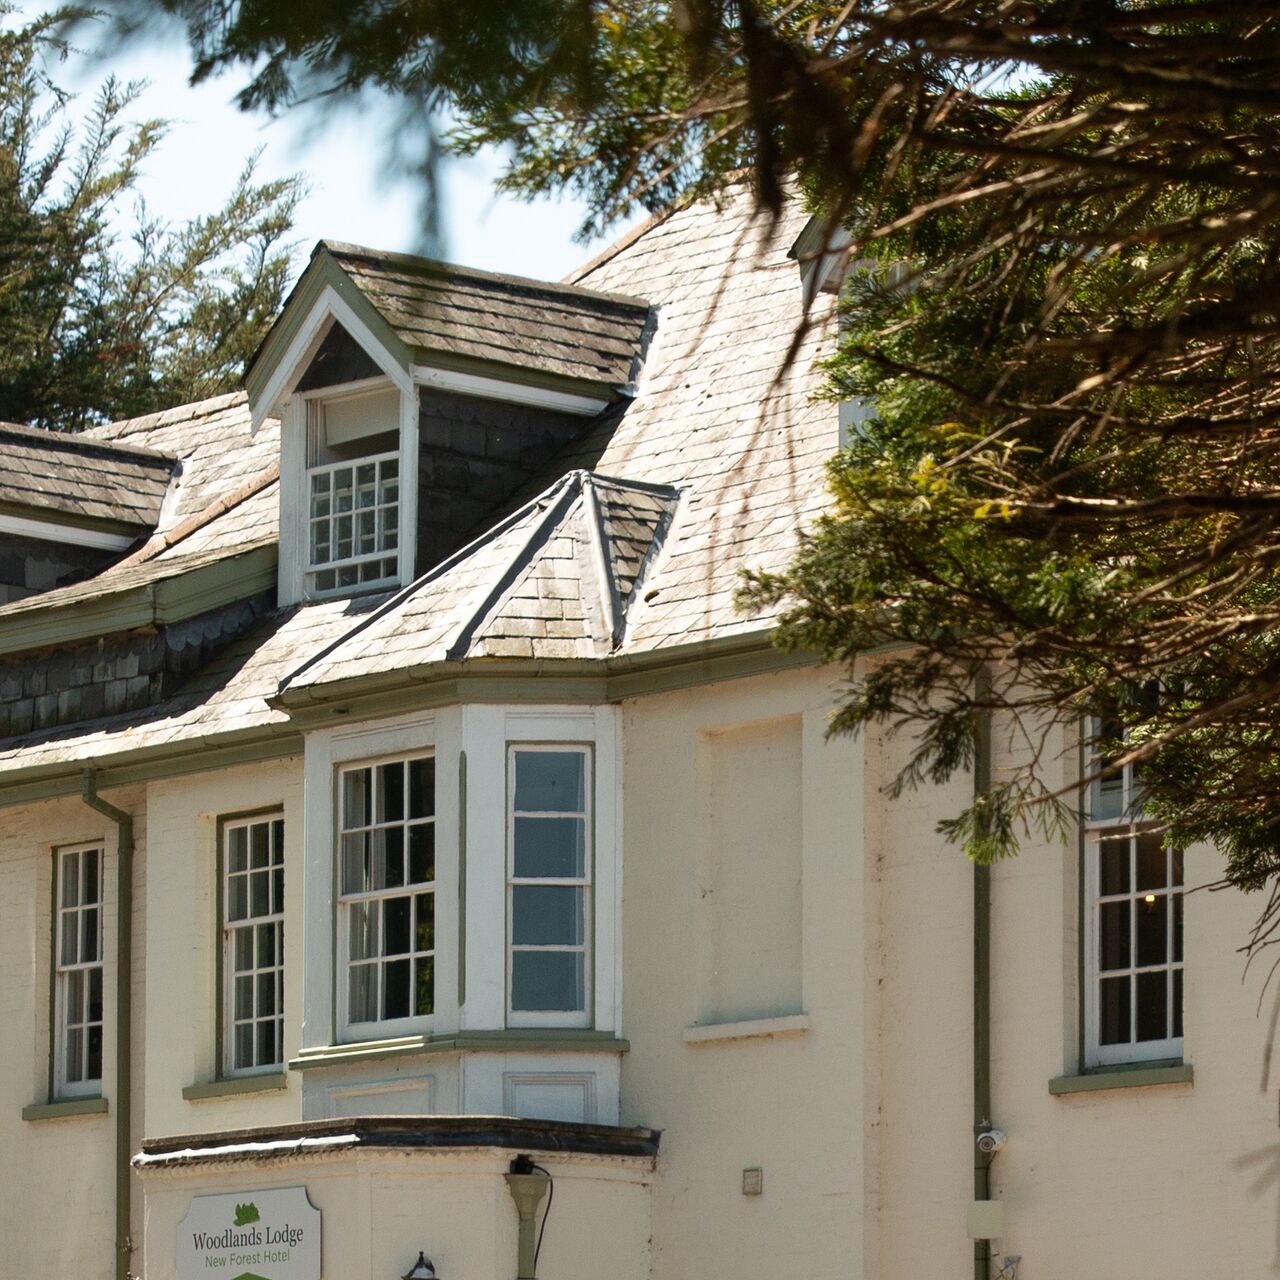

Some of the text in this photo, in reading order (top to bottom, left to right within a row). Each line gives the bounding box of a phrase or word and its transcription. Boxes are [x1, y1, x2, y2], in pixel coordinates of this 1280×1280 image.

[193, 1224, 304, 1251] Woodlands Lodge
[205, 1249, 290, 1268] New Forest Hotel
